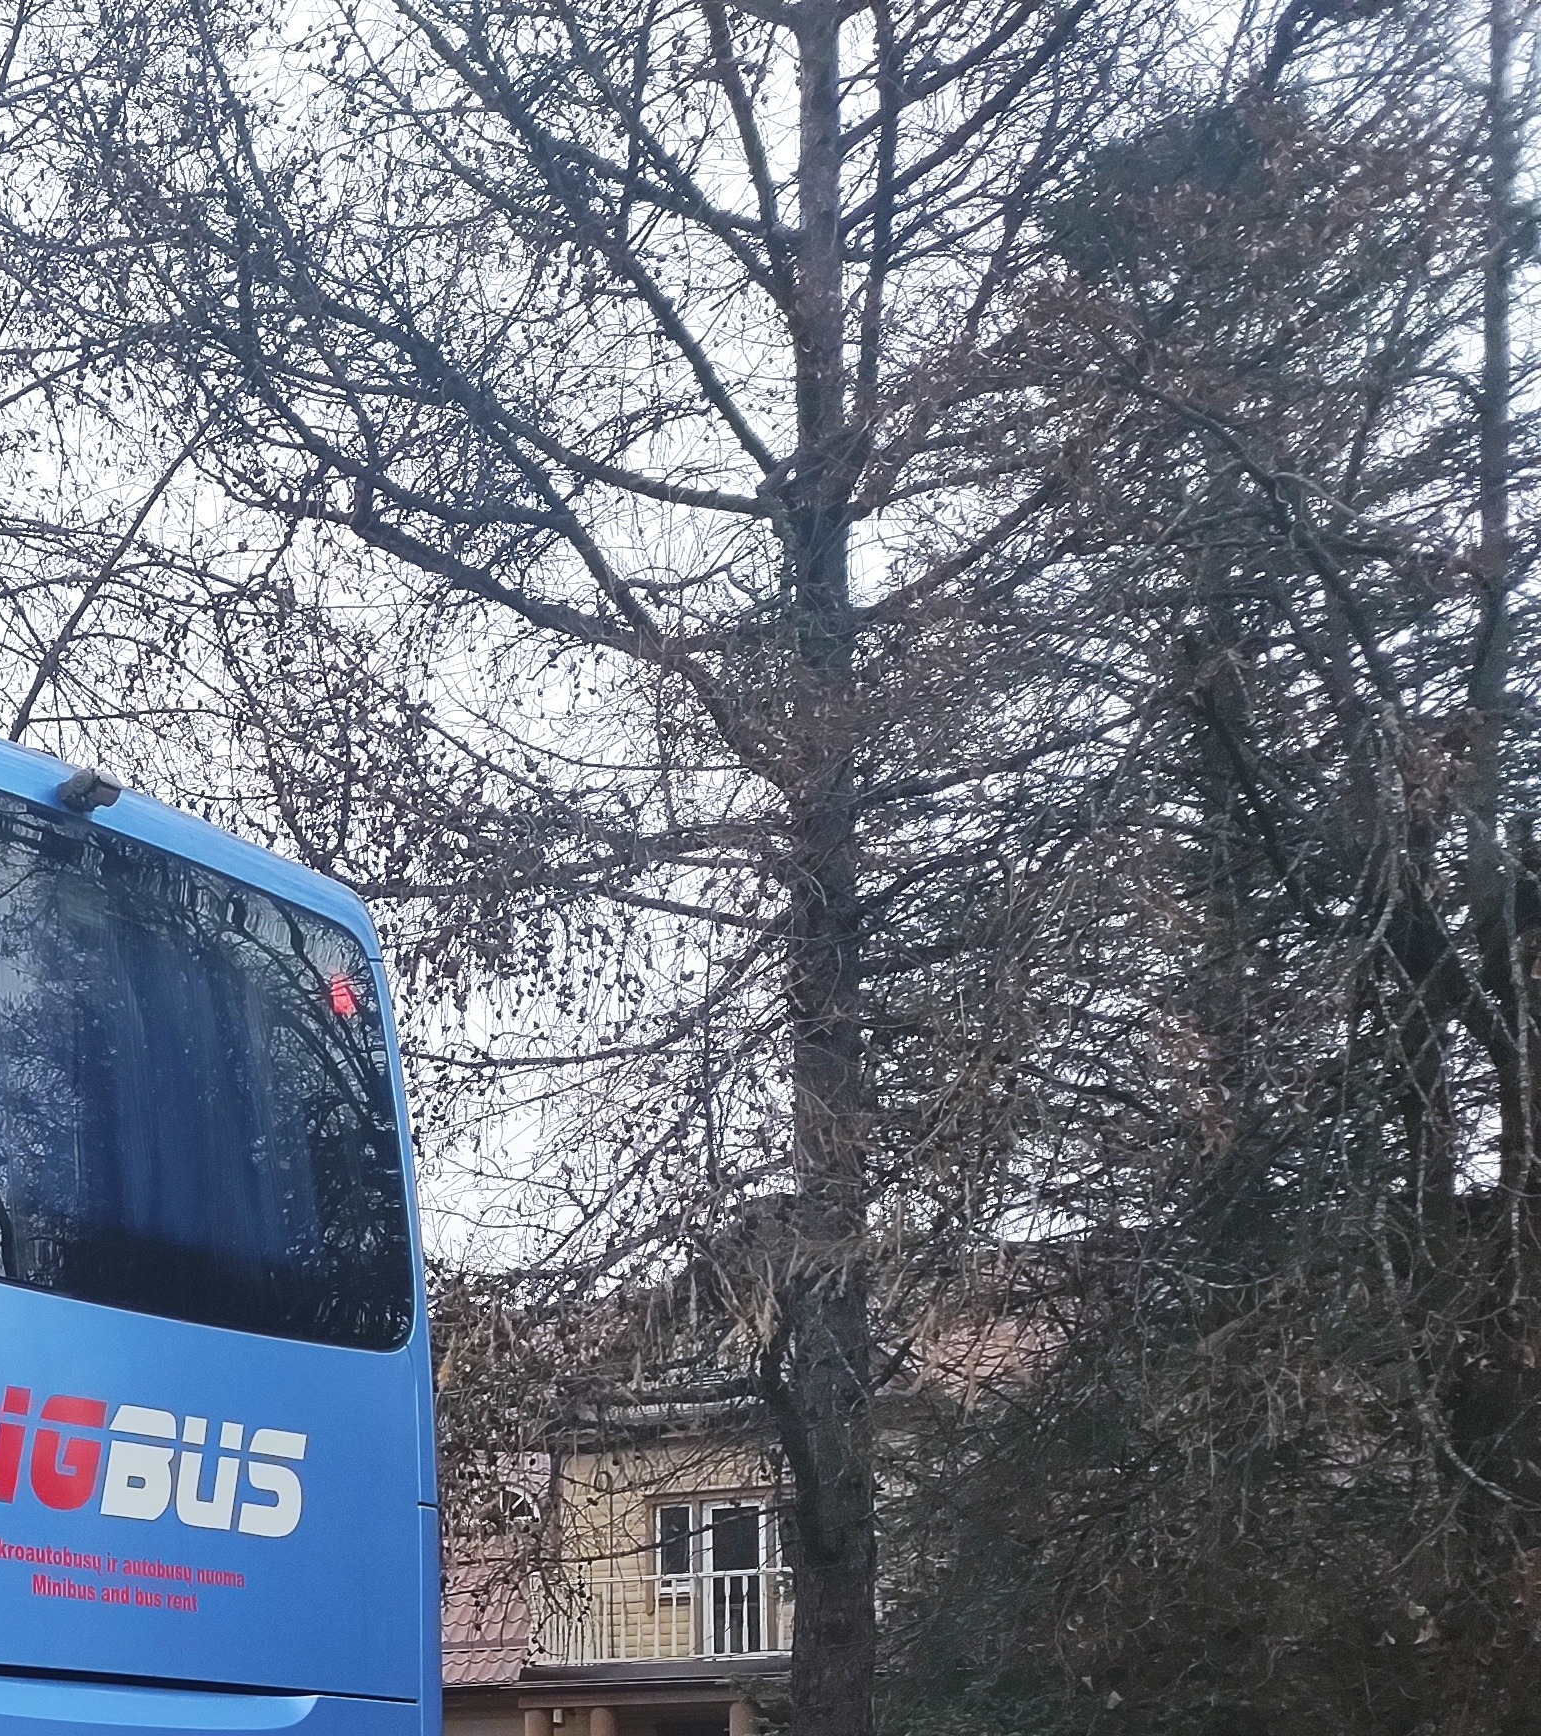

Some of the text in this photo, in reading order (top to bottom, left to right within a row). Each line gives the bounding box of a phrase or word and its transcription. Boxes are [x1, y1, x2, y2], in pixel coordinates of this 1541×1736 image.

[106, 1552, 119, 1573] ir
[123, 1557, 193, 1587] autobusų
[197, 1568, 246, 1588] nuoma
[32, 1573, 199, 1612] Minibus and bus rent
